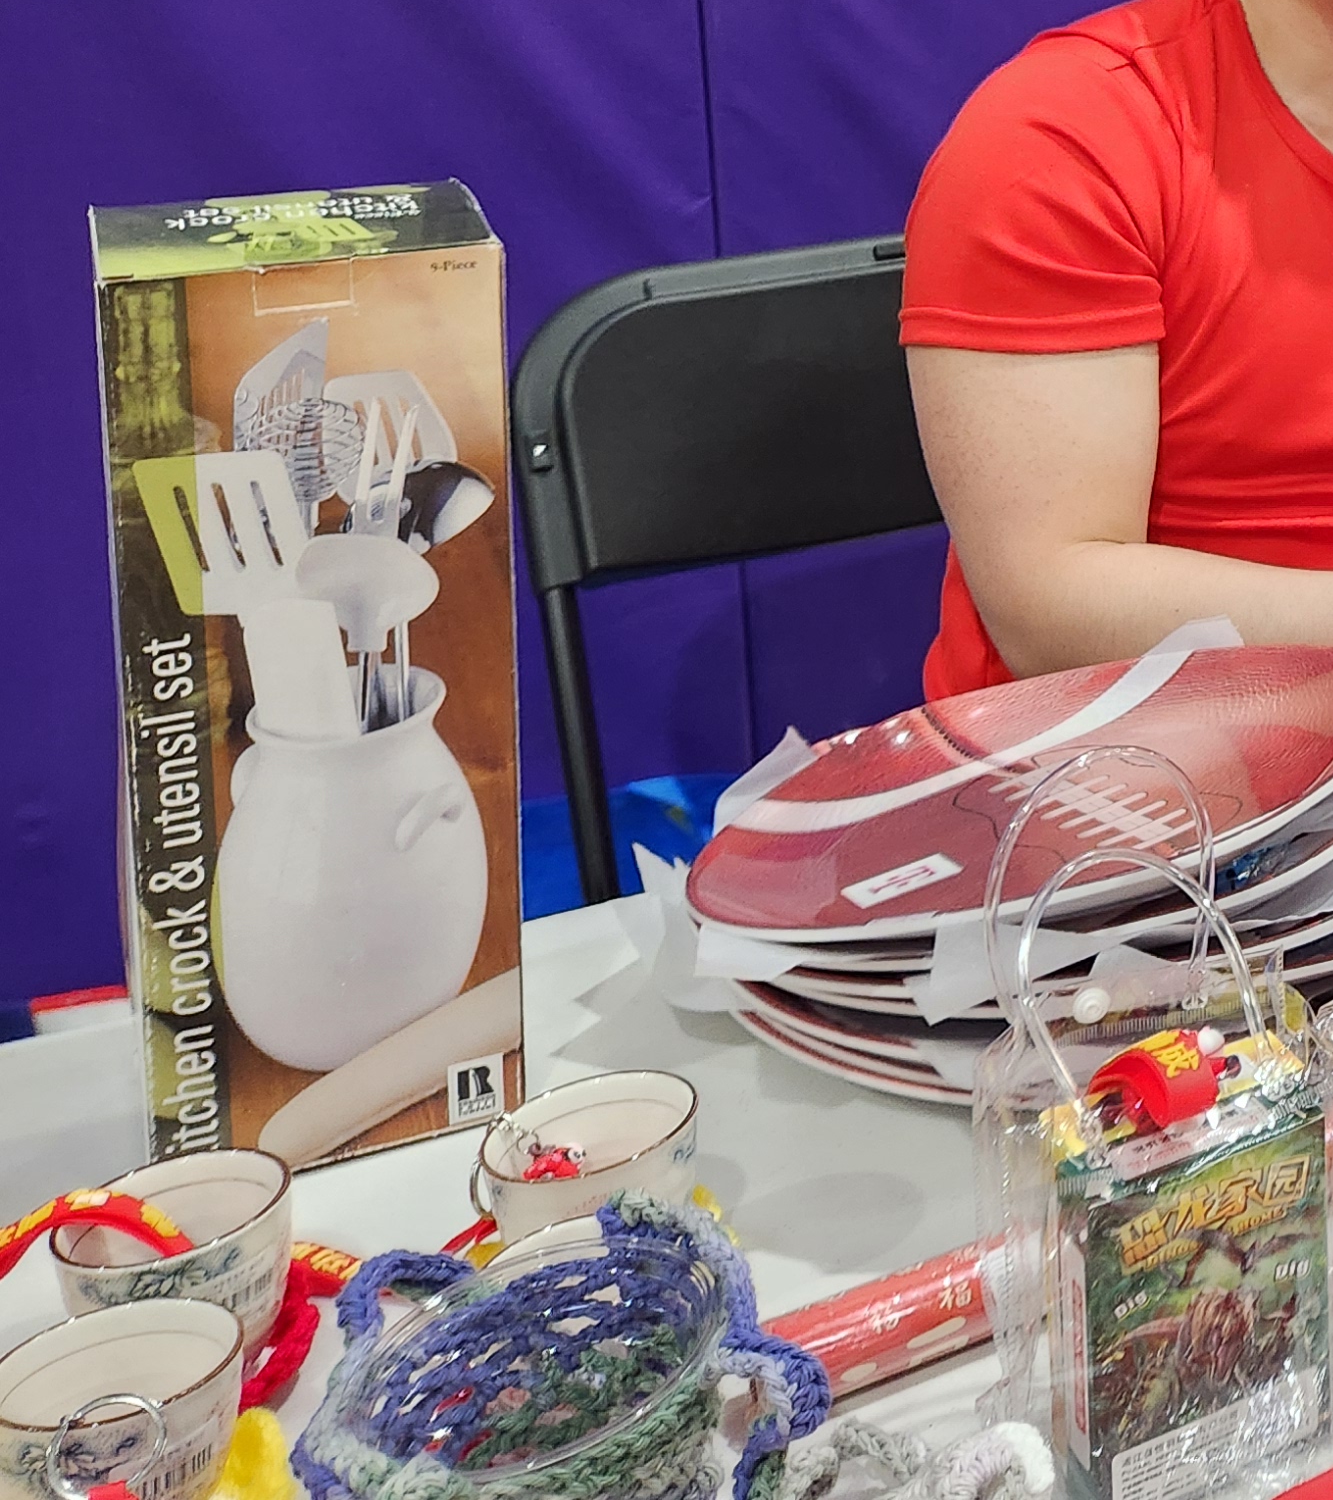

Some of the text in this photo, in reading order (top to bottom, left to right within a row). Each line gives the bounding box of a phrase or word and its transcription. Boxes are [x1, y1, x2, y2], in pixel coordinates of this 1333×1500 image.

[140, 632, 218, 1155] itchen crock & utensil set
[938, 1279, 972, 1310] 福
